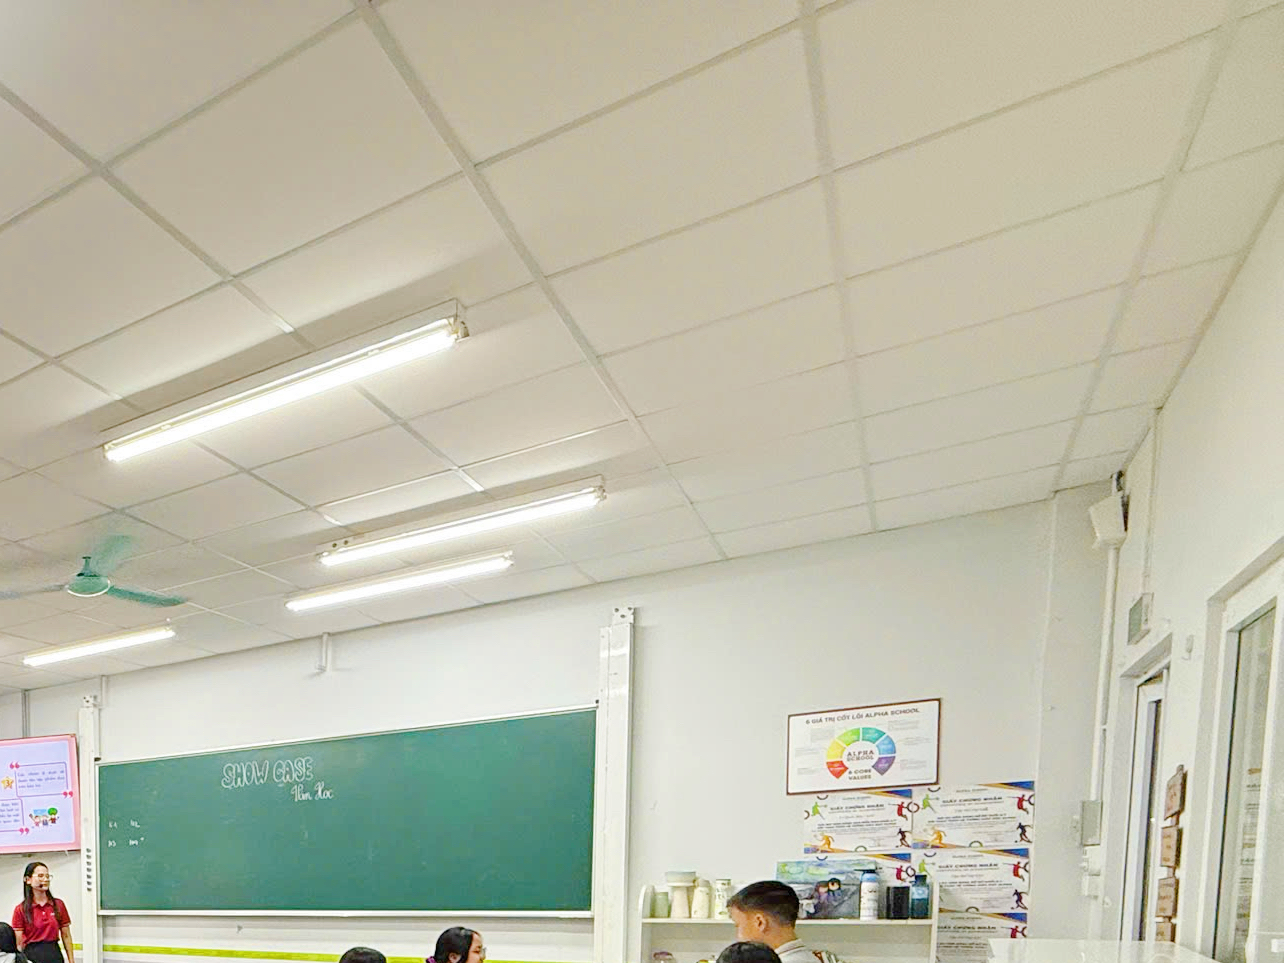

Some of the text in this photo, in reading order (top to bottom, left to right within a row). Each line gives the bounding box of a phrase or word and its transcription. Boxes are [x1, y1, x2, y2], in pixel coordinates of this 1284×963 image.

[865, 711, 889, 719] ALPHA
[890, 708, 920, 716] SCHOOL
[221, 756, 313, 789] SHOW CASE
